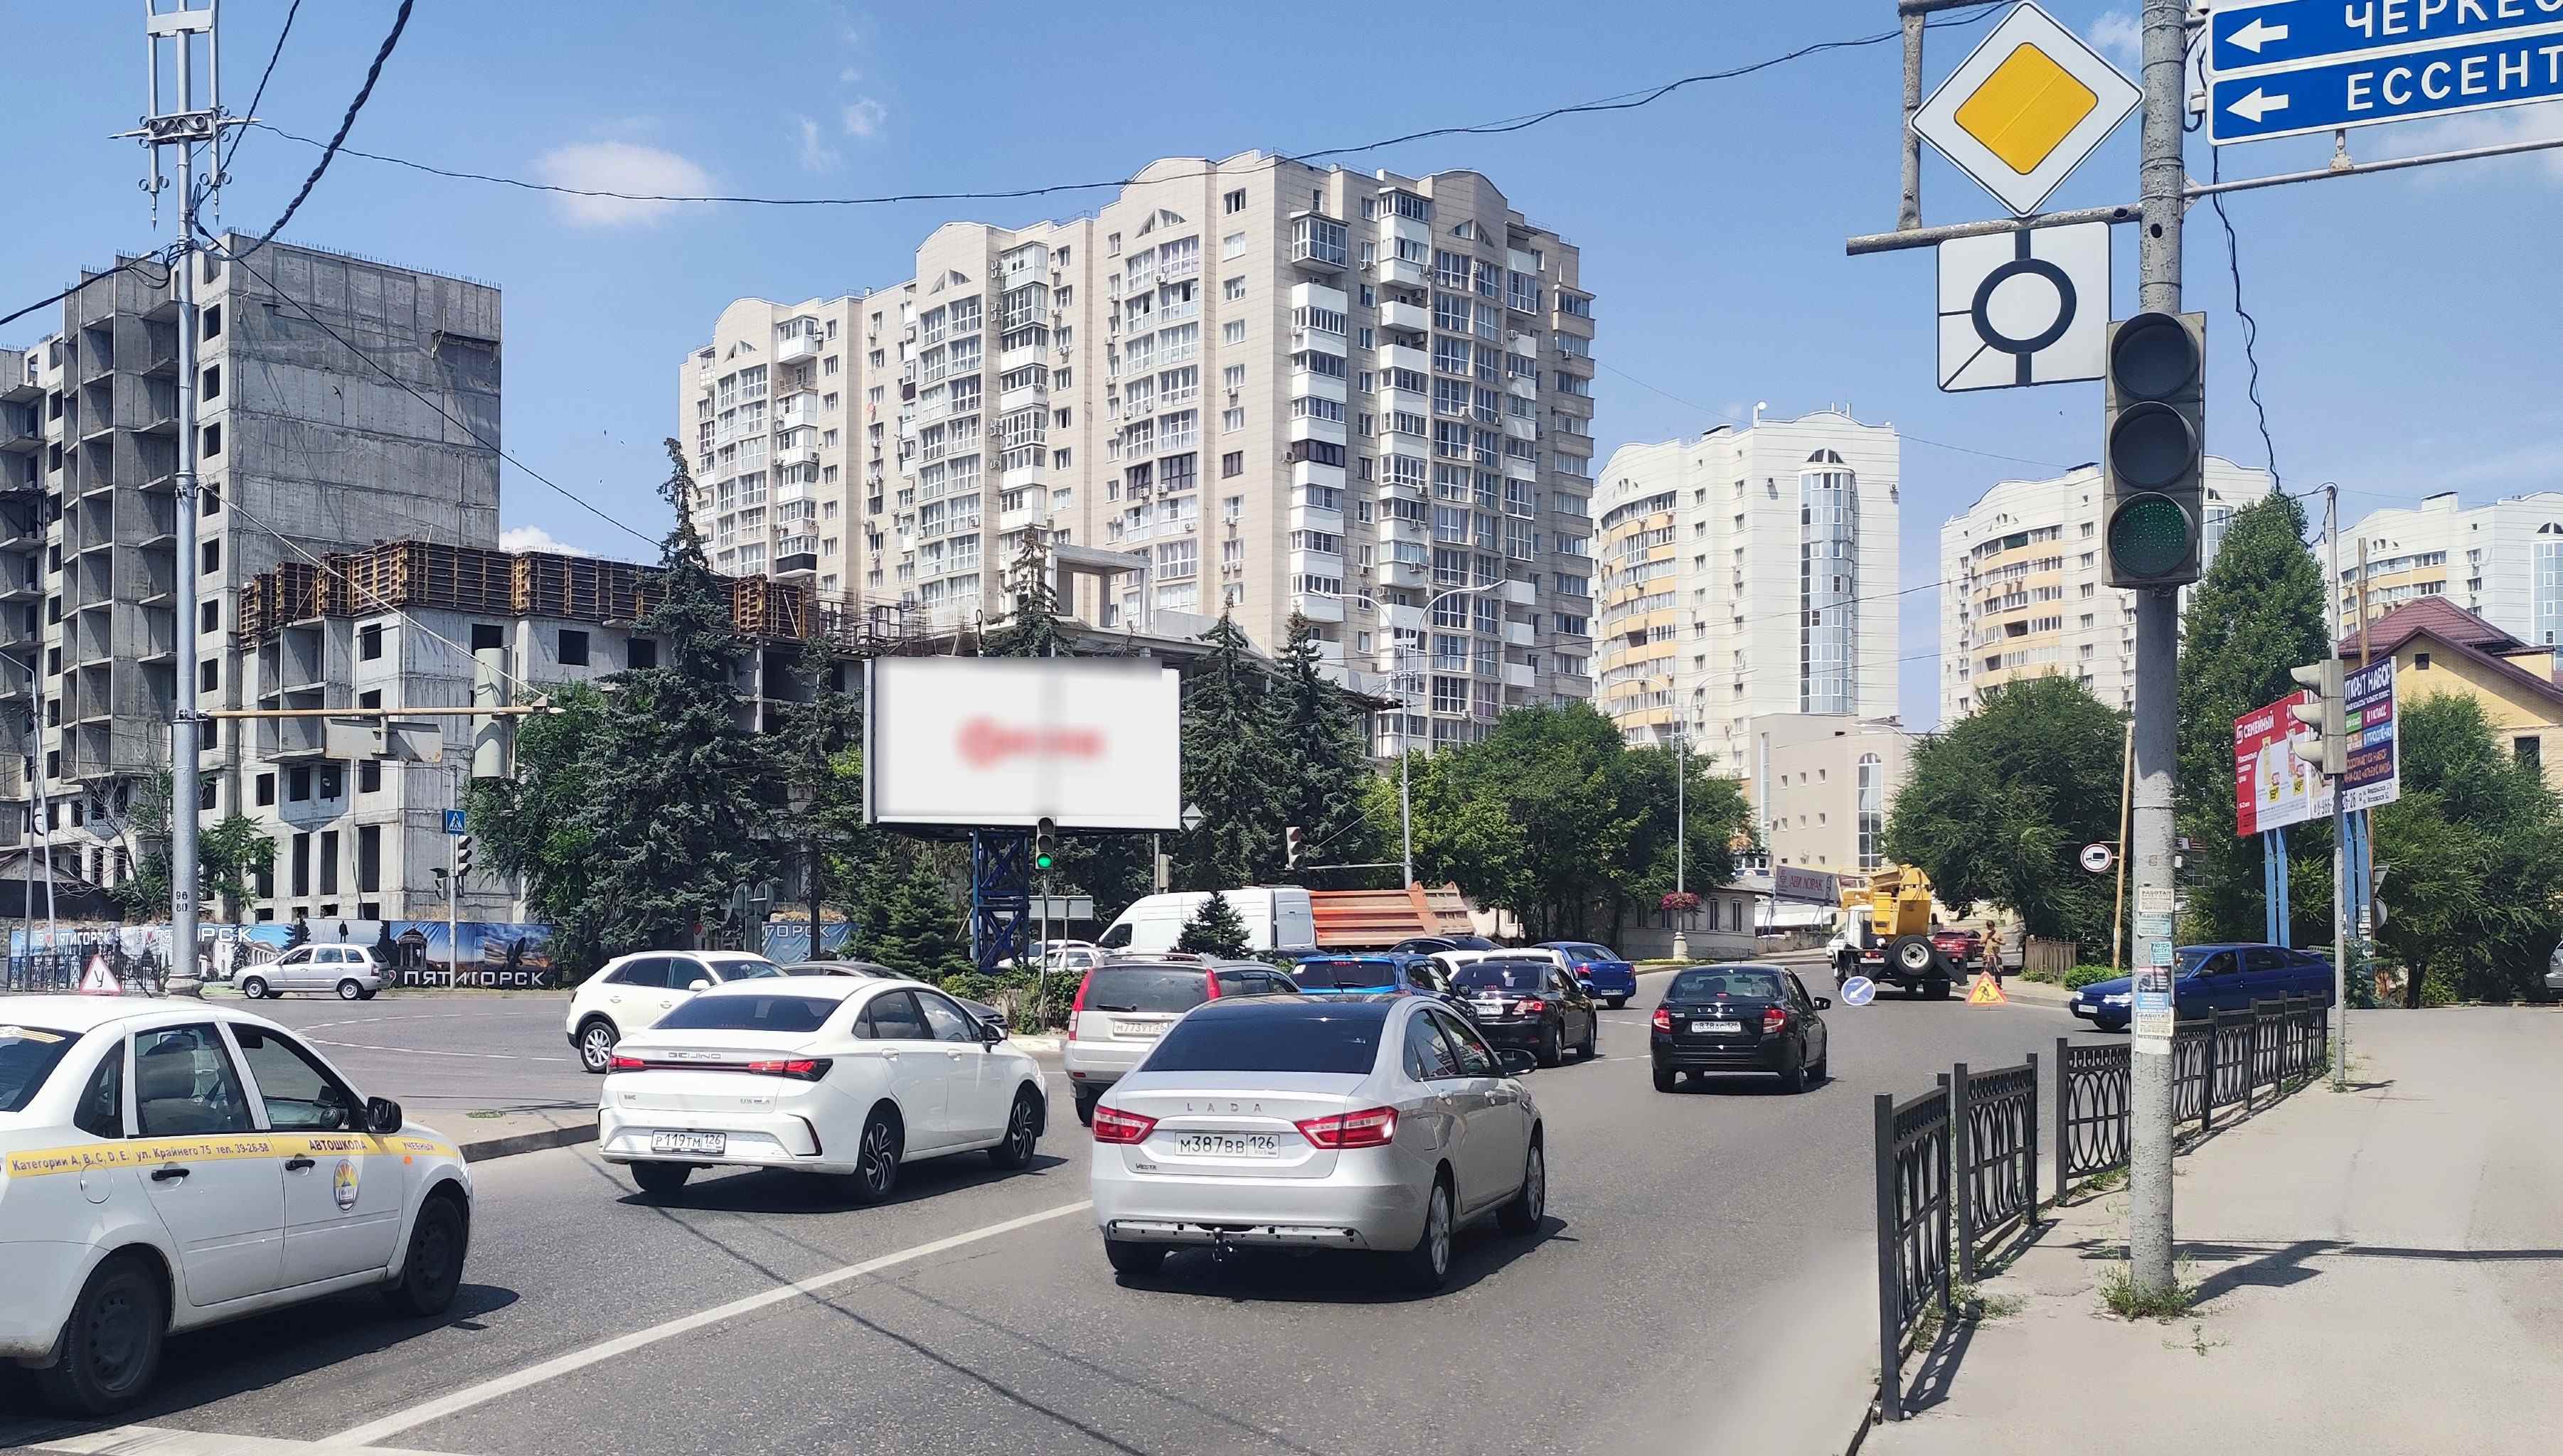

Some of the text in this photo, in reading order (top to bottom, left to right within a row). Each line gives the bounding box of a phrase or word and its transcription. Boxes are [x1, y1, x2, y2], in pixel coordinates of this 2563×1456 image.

[2367, 663, 2391, 693] НАБОР
[2243, 710, 2274, 738] СЕМЕЙНЫЙ
[764, 925, 831, 938] ГОРСК
[93, 969, 105, 987] У
[1187, 1103, 1262, 1113] LADA
[309, 1139, 368, 1152] АВТОШКОЛА
[705, 1135, 720, 1145] 126
[1181, 1135, 1274, 1153] М387ВВ 126
[12, 1153, 68, 1172] Категории
[136, 1150, 151, 1162] ул.
[200, 1144, 212, 1155] 75
